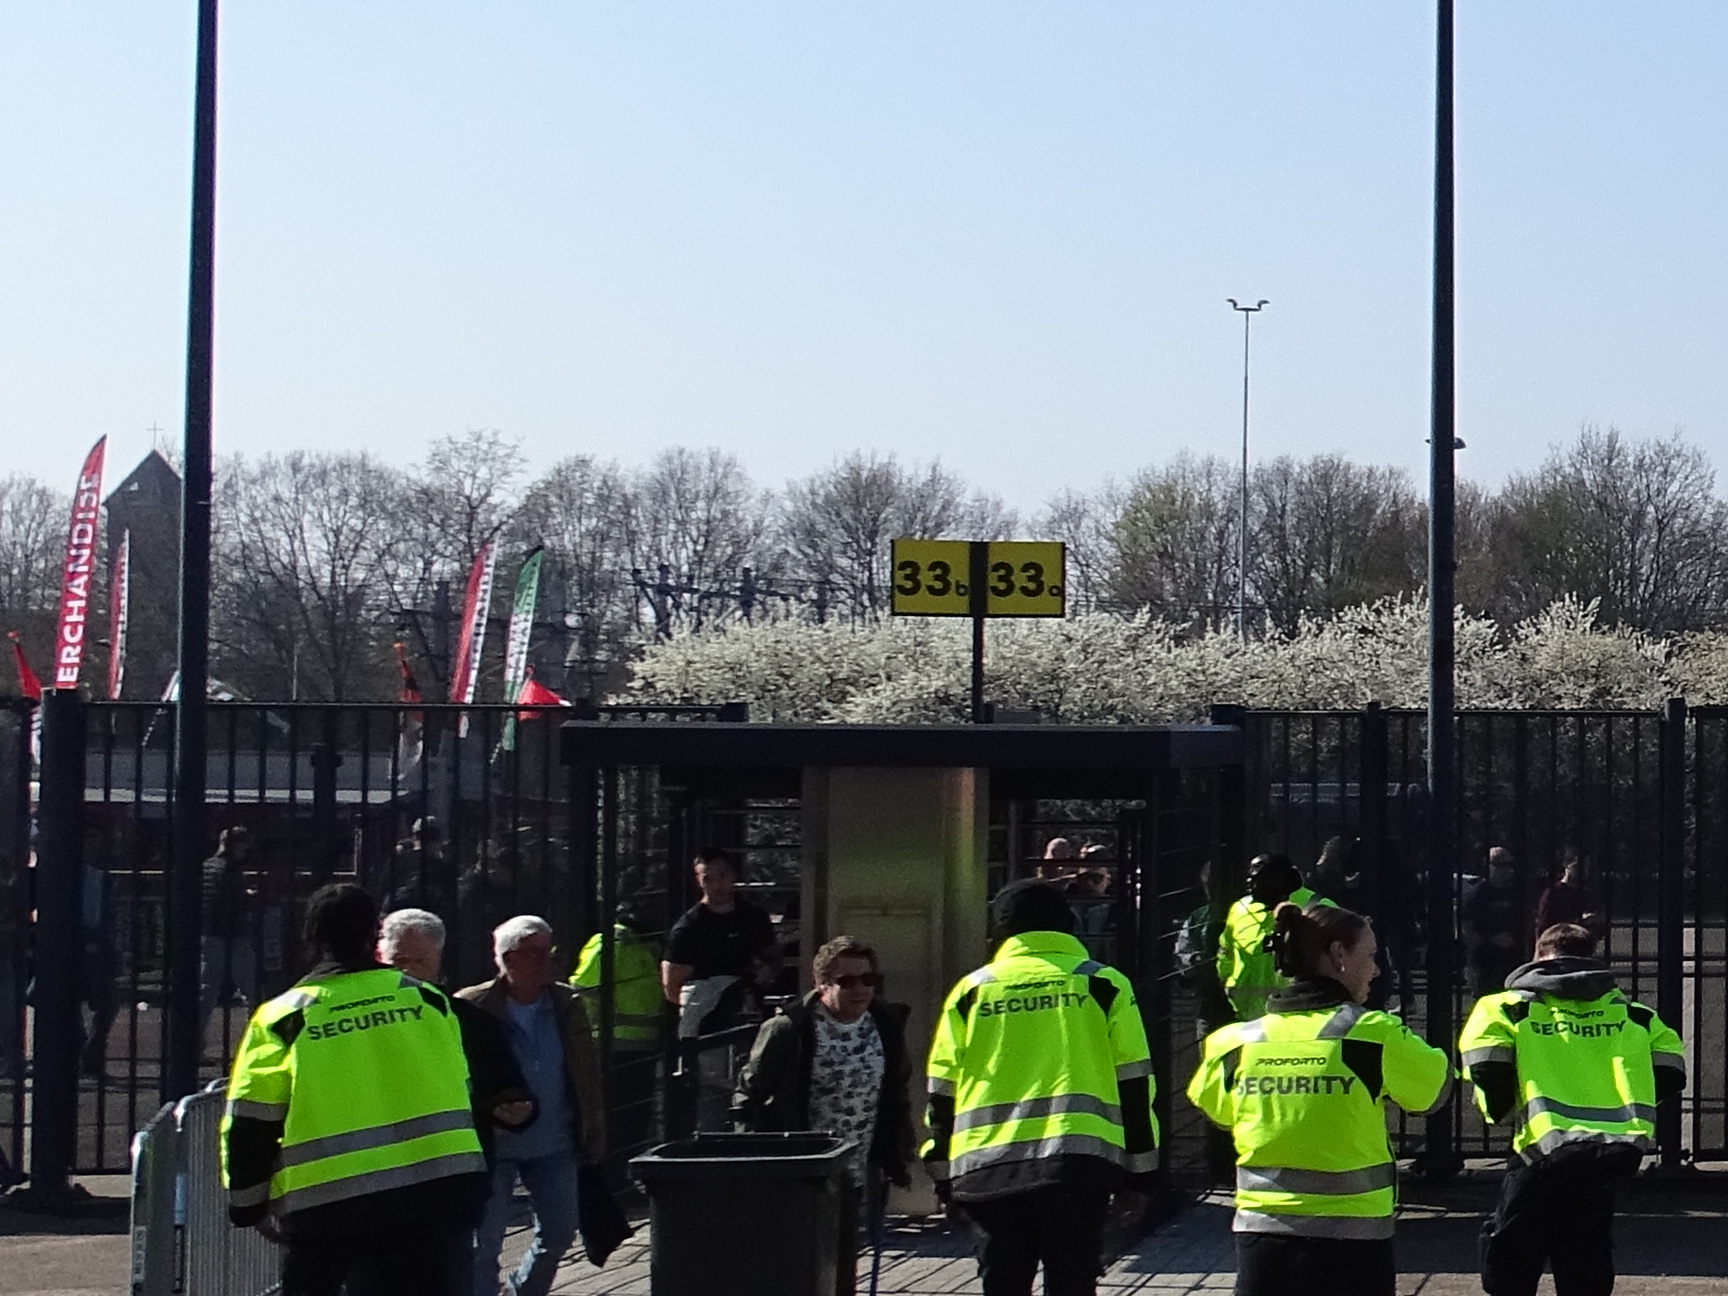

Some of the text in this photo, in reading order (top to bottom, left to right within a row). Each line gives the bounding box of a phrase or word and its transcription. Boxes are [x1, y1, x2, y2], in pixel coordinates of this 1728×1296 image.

[57, 472, 99, 683] ERCHANDISE
[978, 992, 1089, 1018] SECURITY
[306, 1005, 423, 1041] SECURITY
[1530, 1020, 1626, 1038] SECURITY
[1255, 1056, 1327, 1067] PROFORTO
[1237, 1075, 1357, 1096] SECURITY
